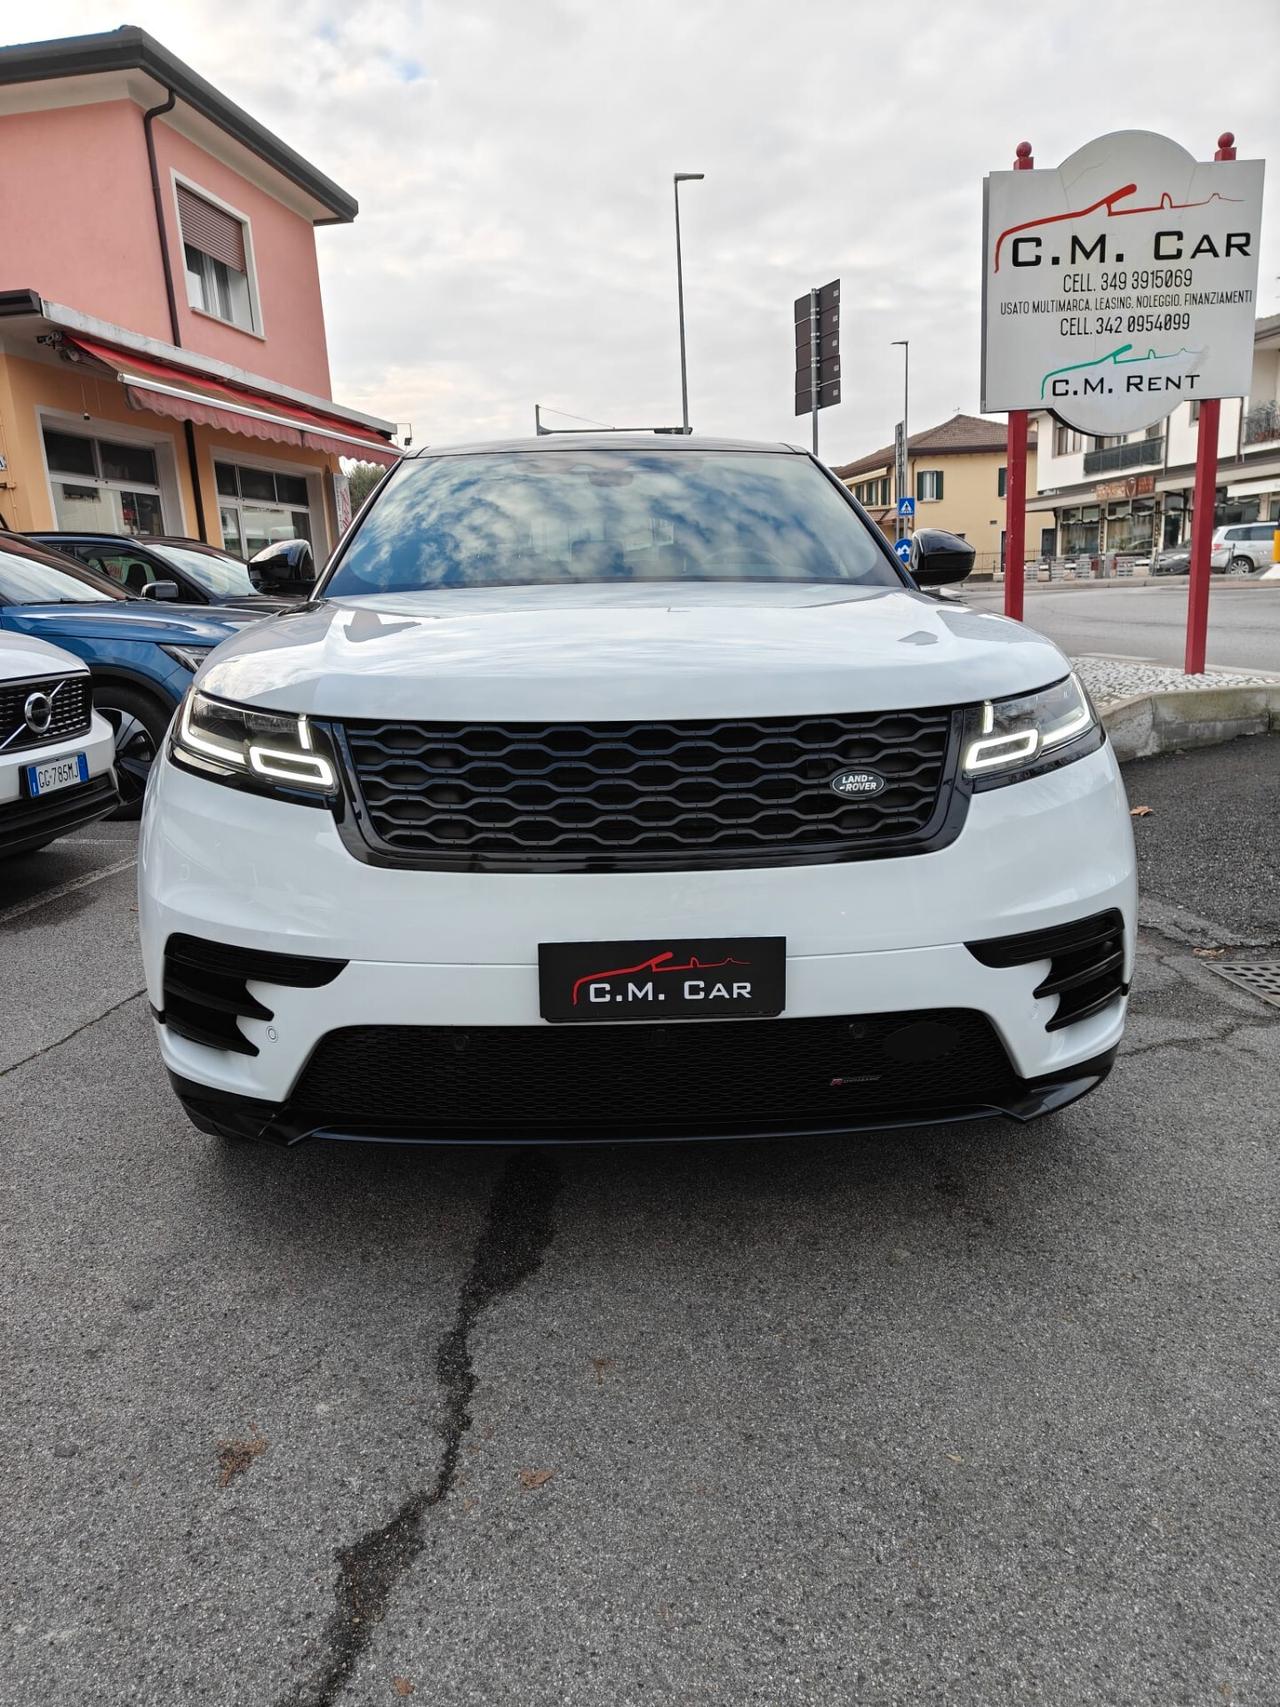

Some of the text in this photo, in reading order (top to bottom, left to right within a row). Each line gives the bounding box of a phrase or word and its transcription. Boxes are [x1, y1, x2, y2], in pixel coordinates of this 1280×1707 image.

[1011, 233, 1125, 268] C.M.
[1062, 268, 1193, 293] CELL. 349 3915069
[1000, 301, 1030, 316] USATO
[1184, 289, 1253, 307] FINANZIAMENTI
[1060, 312, 1190, 337] CELL. 342 0954099
[1052, 376, 1113, 397] C.M.
[589, 982, 665, 1003] C.M.
